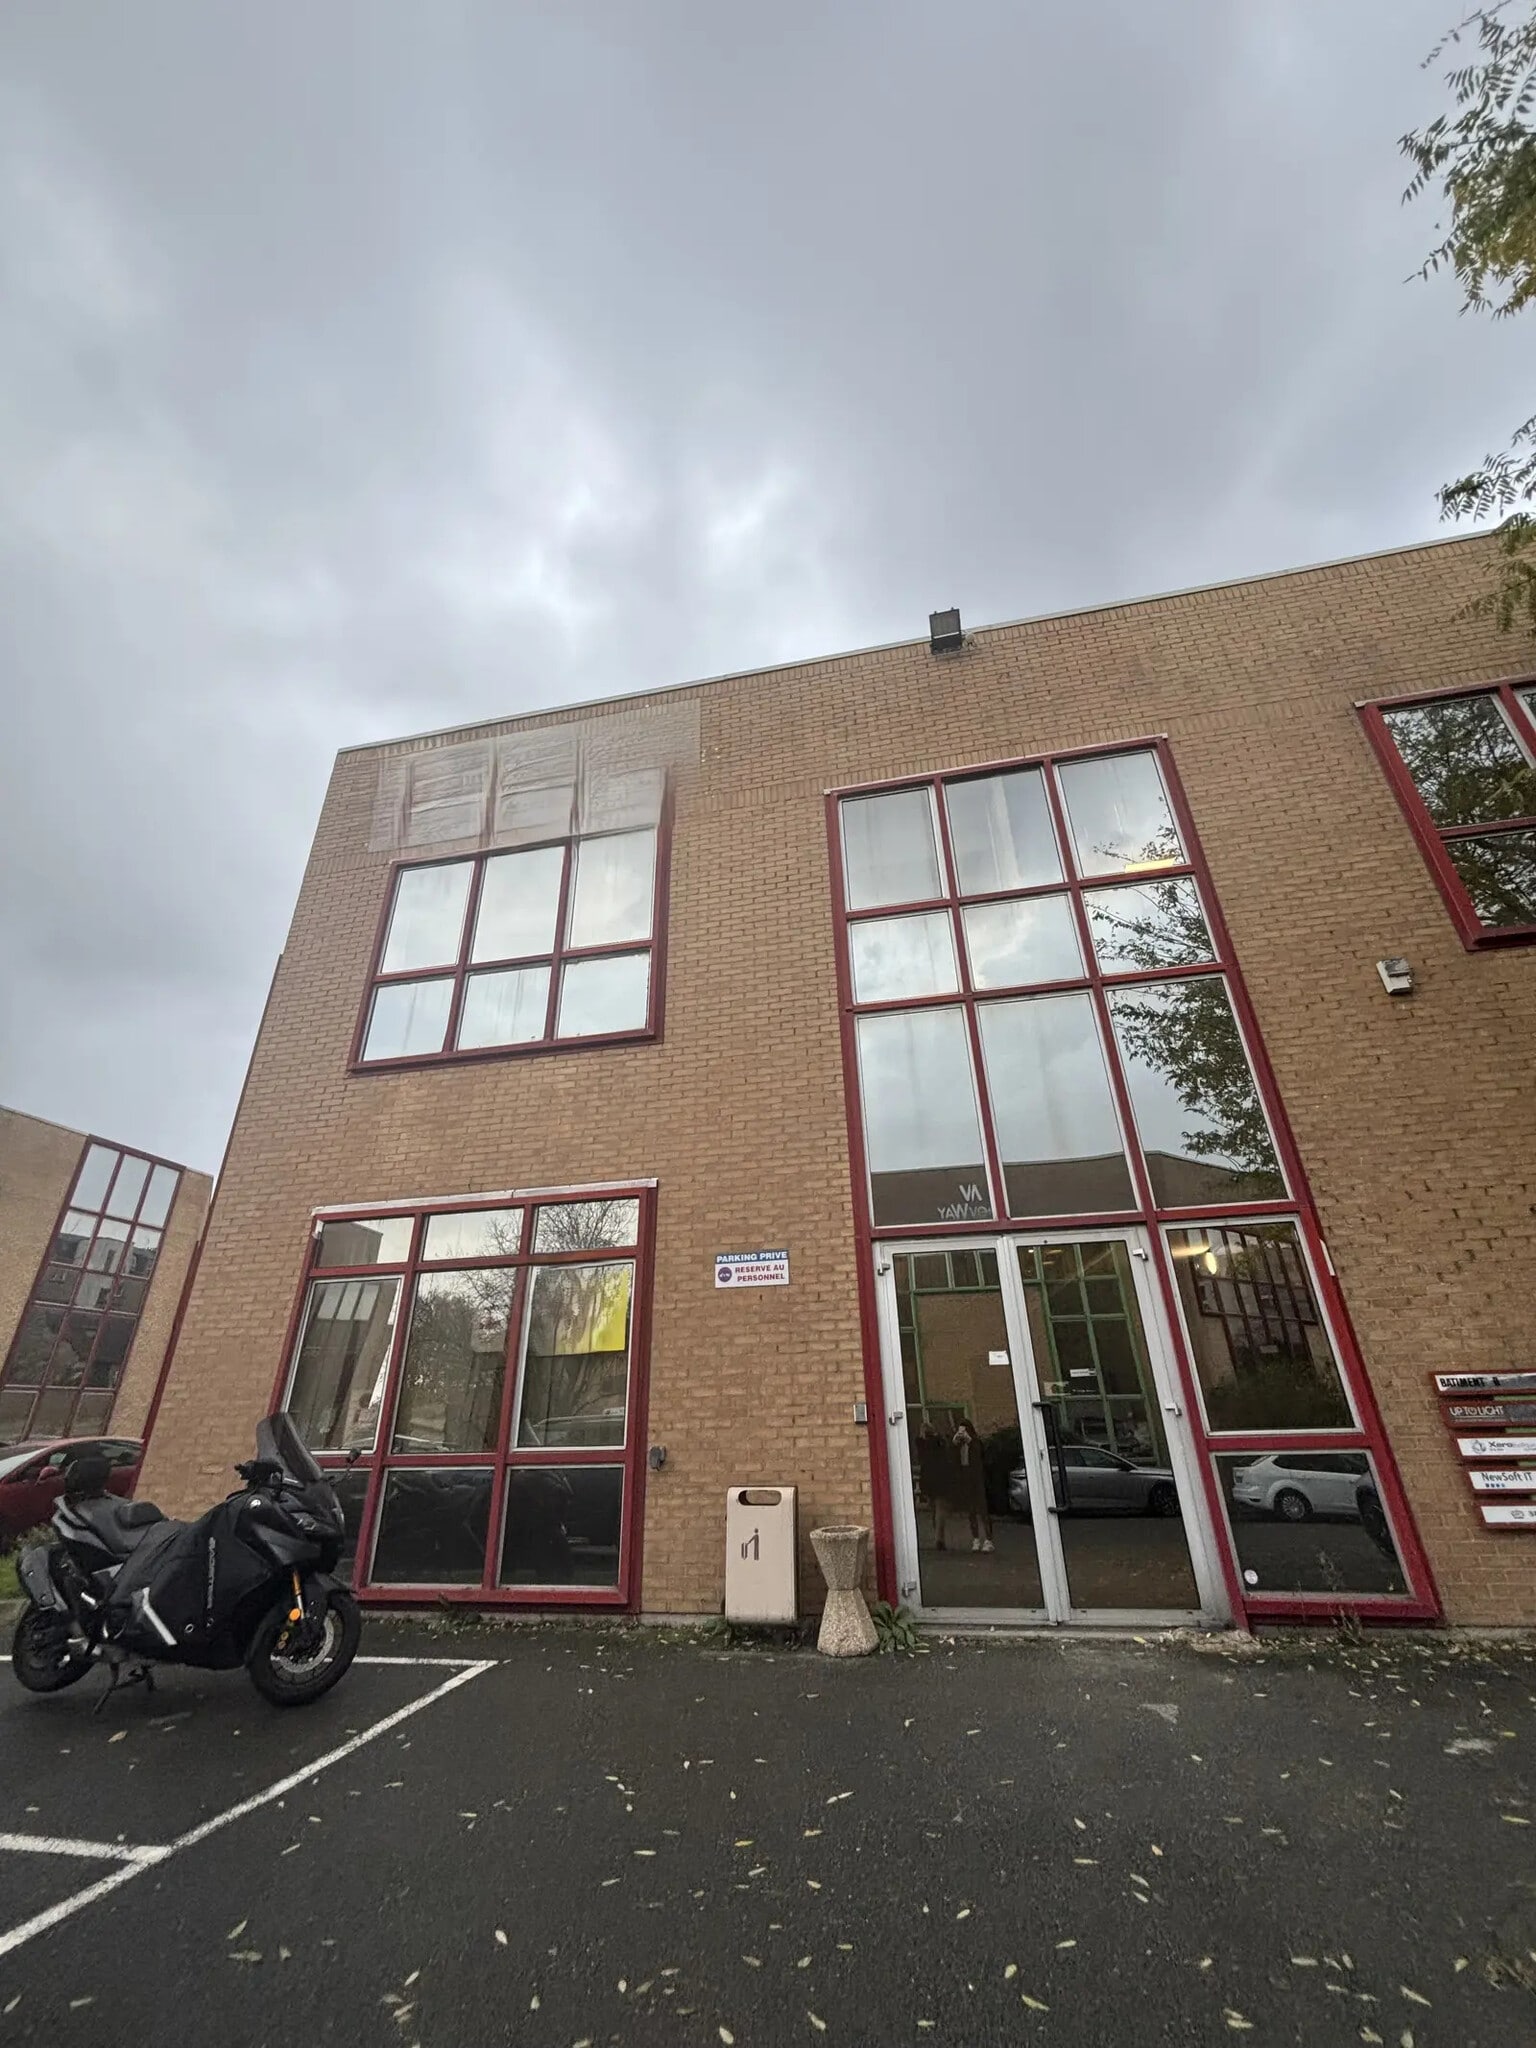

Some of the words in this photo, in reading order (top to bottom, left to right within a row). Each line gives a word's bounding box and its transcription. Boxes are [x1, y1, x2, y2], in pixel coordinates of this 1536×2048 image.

[716, 1253, 757, 1263] PARKING
[759, 1251, 788, 1260] PRIVE
[735, 1265, 771, 1273] RESERVE
[737, 1273, 785, 1282] PERSONNEL
[1439, 1377, 1486, 1388] BATIMENT
[1481, 1472, 1523, 1481] NewSoft
[1524, 1472, 1533, 1481] IT
